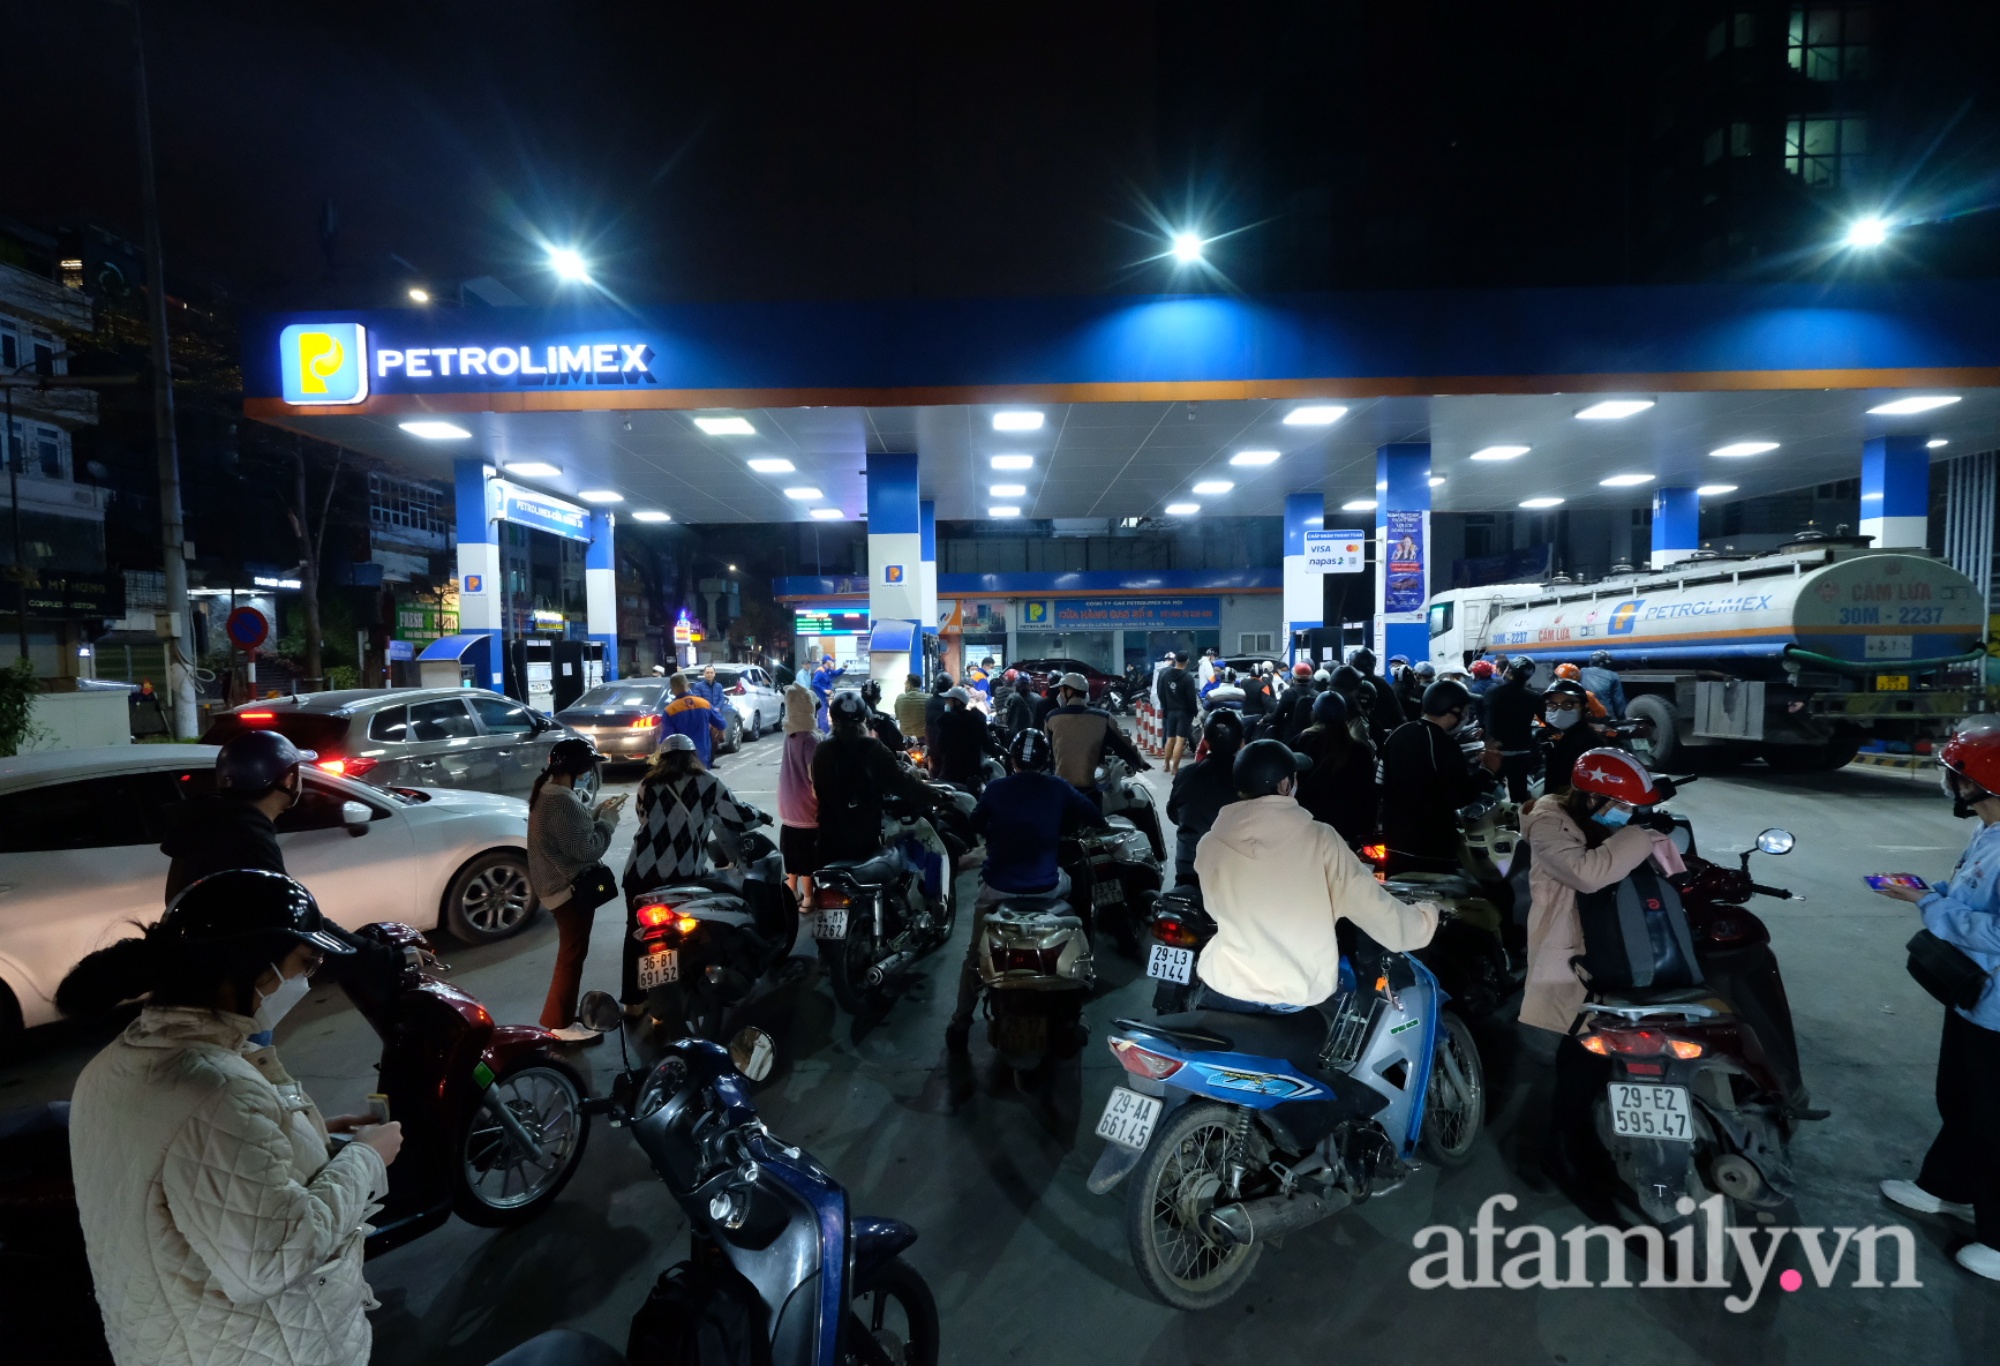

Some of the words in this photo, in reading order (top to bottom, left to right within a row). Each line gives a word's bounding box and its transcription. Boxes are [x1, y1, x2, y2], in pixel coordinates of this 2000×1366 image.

[376, 344, 648, 377] PETROLIMEX
[1311, 545, 1331, 553] VISA
[1309, 557, 1336, 567] napas
[1645, 595, 1773, 620] PETROLIMEX
[1840, 607, 1879, 625] 30M
[1899, 606, 1944, 625] 2237
[817, 924, 842, 937] 7262
[643, 952, 672, 971] 36-B1
[1155, 946, 1188, 965] 29-L3
[640, 966, 677, 987] 691.52
[1152, 962, 1183, 981] 9144
[1112, 1092, 1152, 1122] 29-AA
[1619, 1086, 1677, 1111] 29-E2
[1100, 1112, 1149, 1147] 661.45
[1616, 1110, 1686, 1137] 595.47
